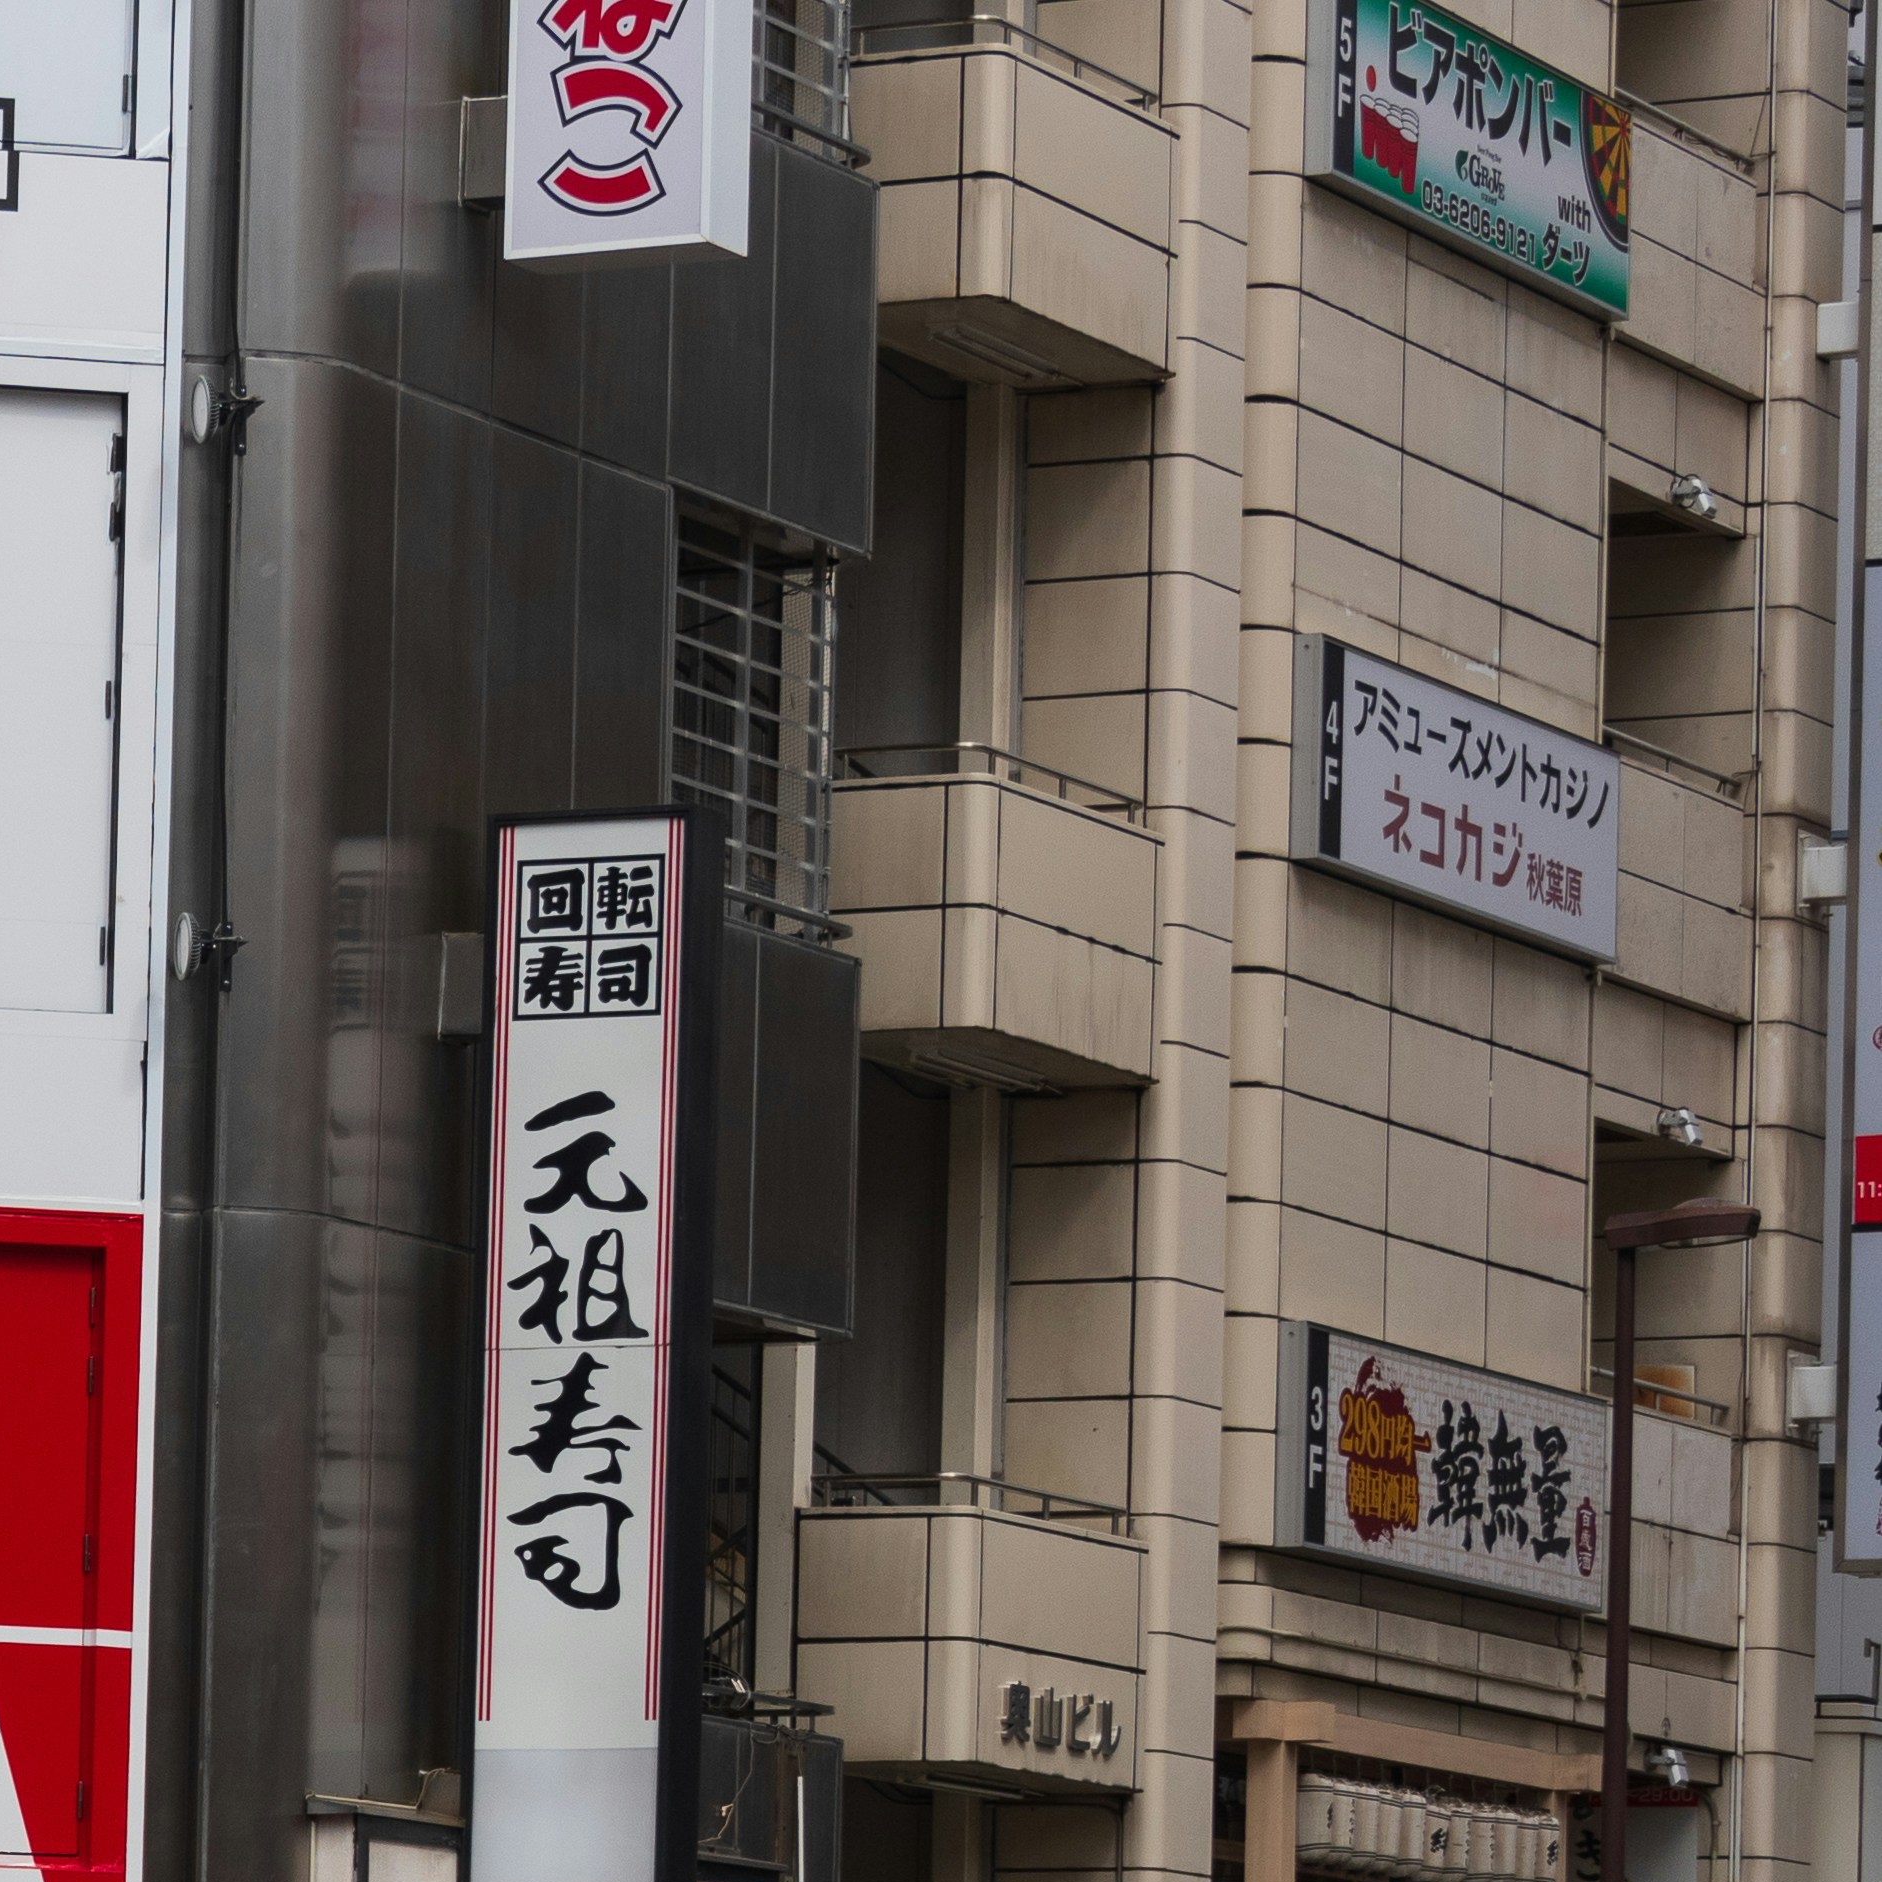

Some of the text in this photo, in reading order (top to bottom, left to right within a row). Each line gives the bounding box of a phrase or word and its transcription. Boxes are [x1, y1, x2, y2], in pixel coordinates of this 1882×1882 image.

[1387, 2, 1572, 167] ビアポンバー
[1422, 180, 1538, 265] 03-6206-9121
[1543, 222, 1590, 285] ダーツ
[1557, 193, 1592, 234] with
[1352, 678, 1609, 830] アミューズメントカジノ
[1381, 773, 1583, 917] ネコカジ 秋葉原
[522, 944, 653, 1011] 寿司
[507, 1091, 648, 1610] 元祖寿司
[1307, 1385, 1327, 1490] 3F
